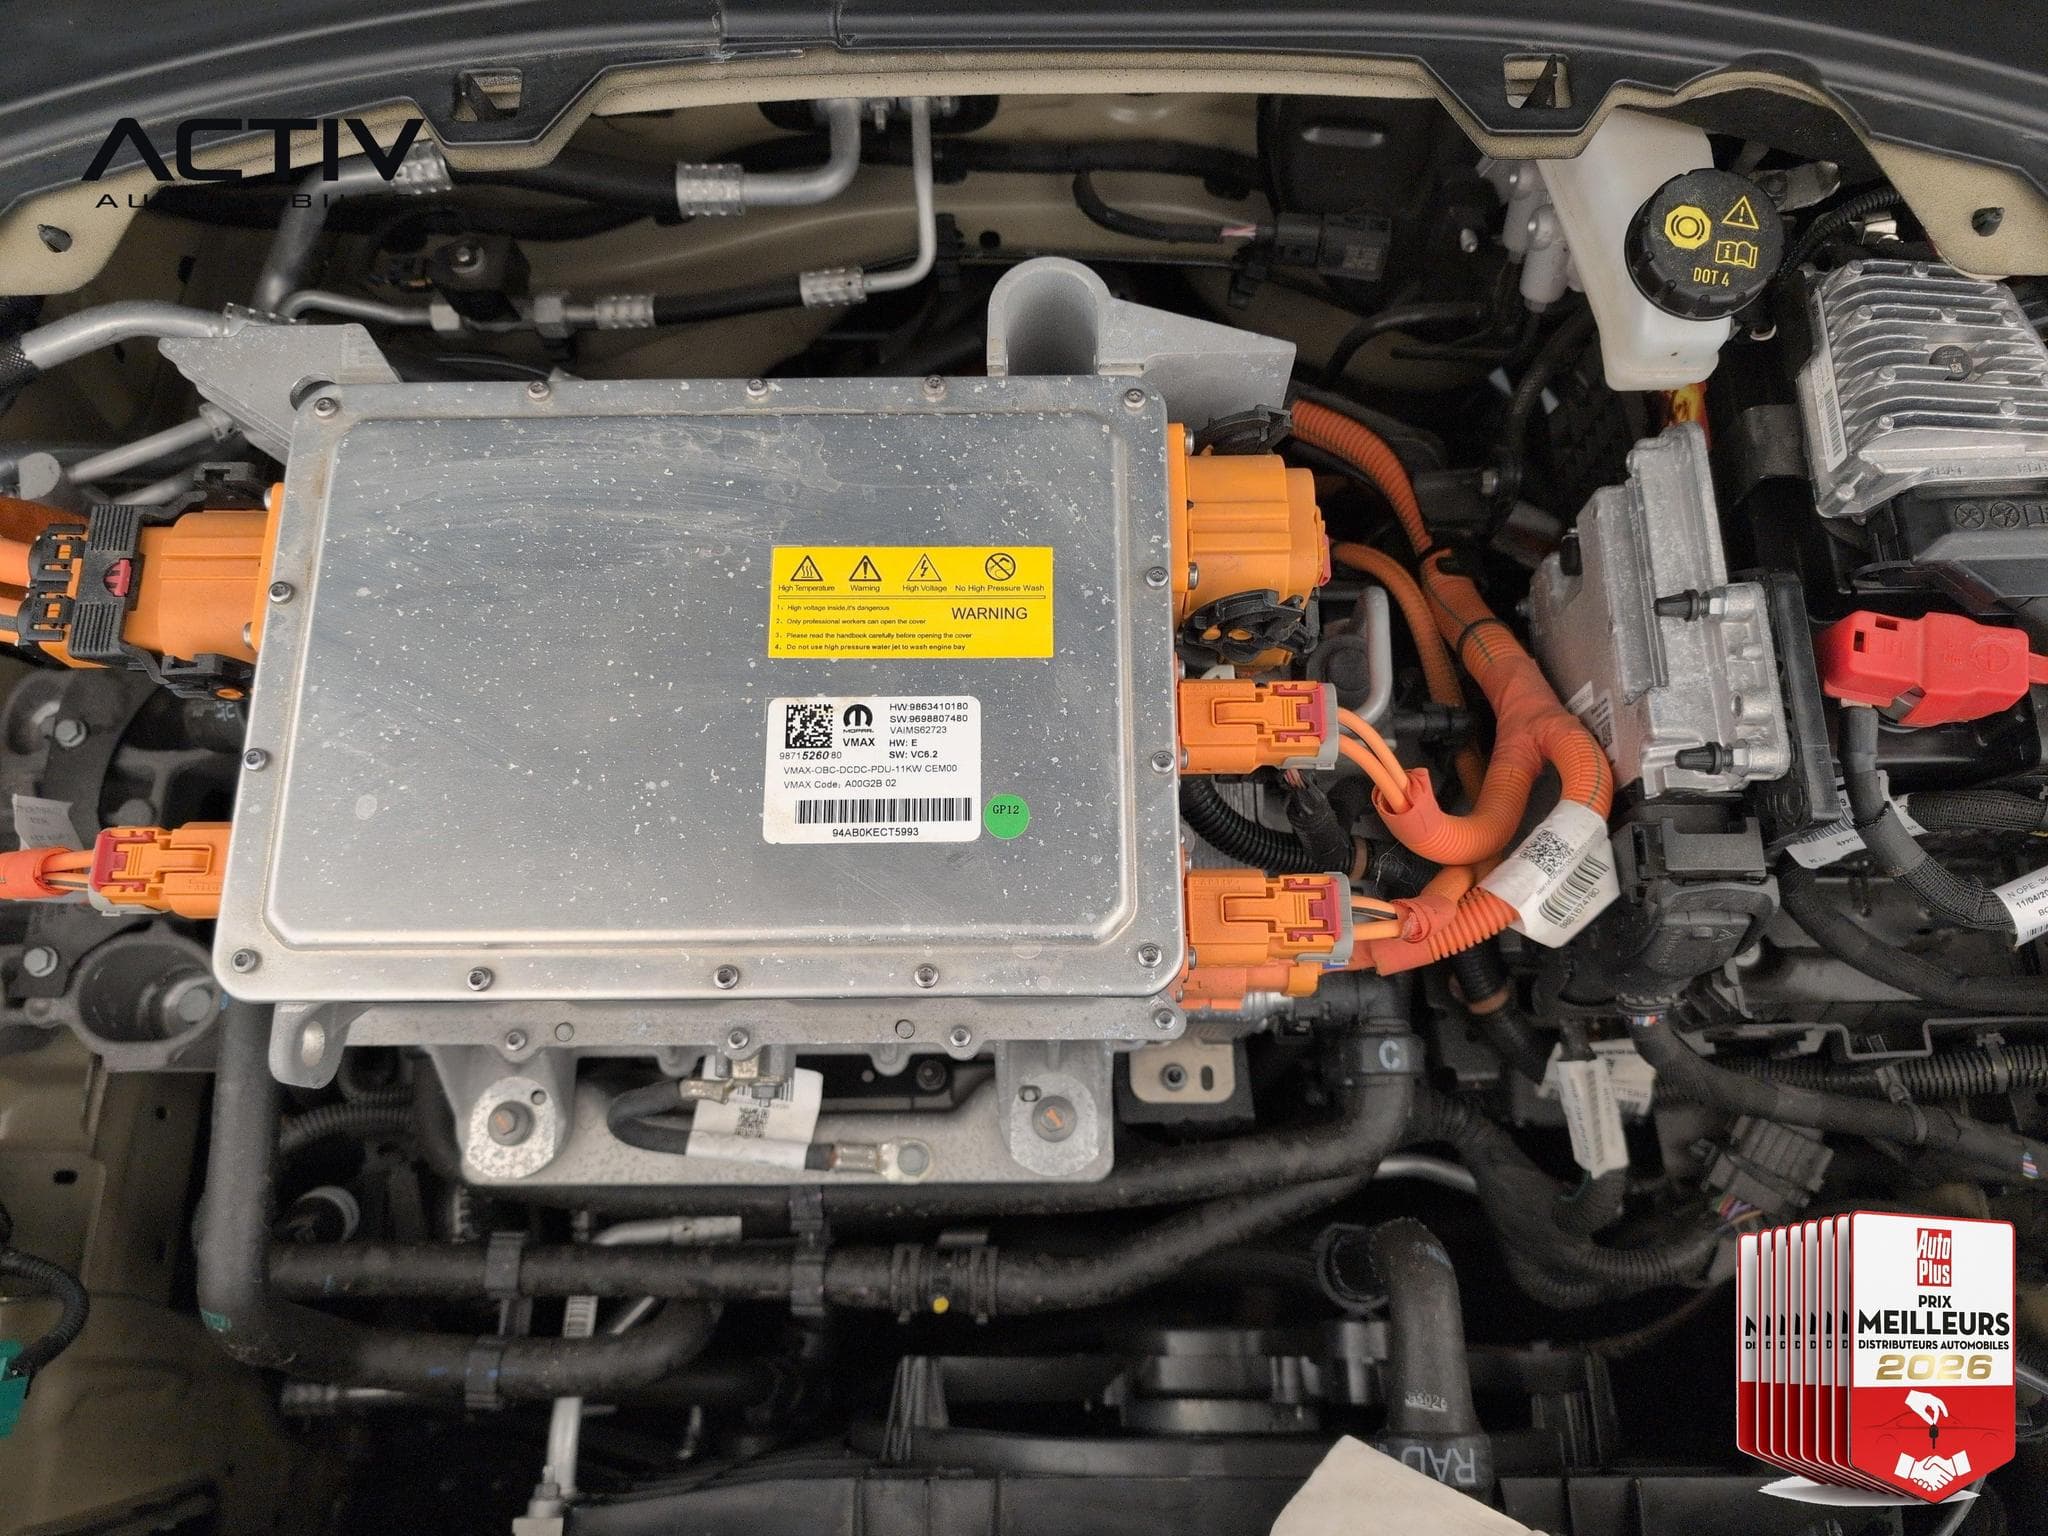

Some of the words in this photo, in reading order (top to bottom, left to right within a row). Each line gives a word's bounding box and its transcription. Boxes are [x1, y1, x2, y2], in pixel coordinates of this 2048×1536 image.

[1693, 267, 1719, 285] DOT
[1721, 272, 1730, 287] 4
[902, 584, 919, 592] High
[920, 584, 947, 592] Voltage
[968, 584, 985, 592] High
[952, 607, 1028, 620] WARNING
[890, 726, 947, 734] VAIMS62723
[843, 738, 875, 747] VMAX
[889, 739, 908, 747] HW:
[911, 739, 918, 747] E
[889, 751, 908, 759] SW:
[784, 765, 922, 774] VMAX-OBC-DCDC-PDU-11KW
[992, 804, 1020, 815] GP12
[832, 827, 919, 837] 94AB0KECT5993
[1379, 1040, 1401, 1070] C
[1401, 1446, 1476, 1484] RAD
